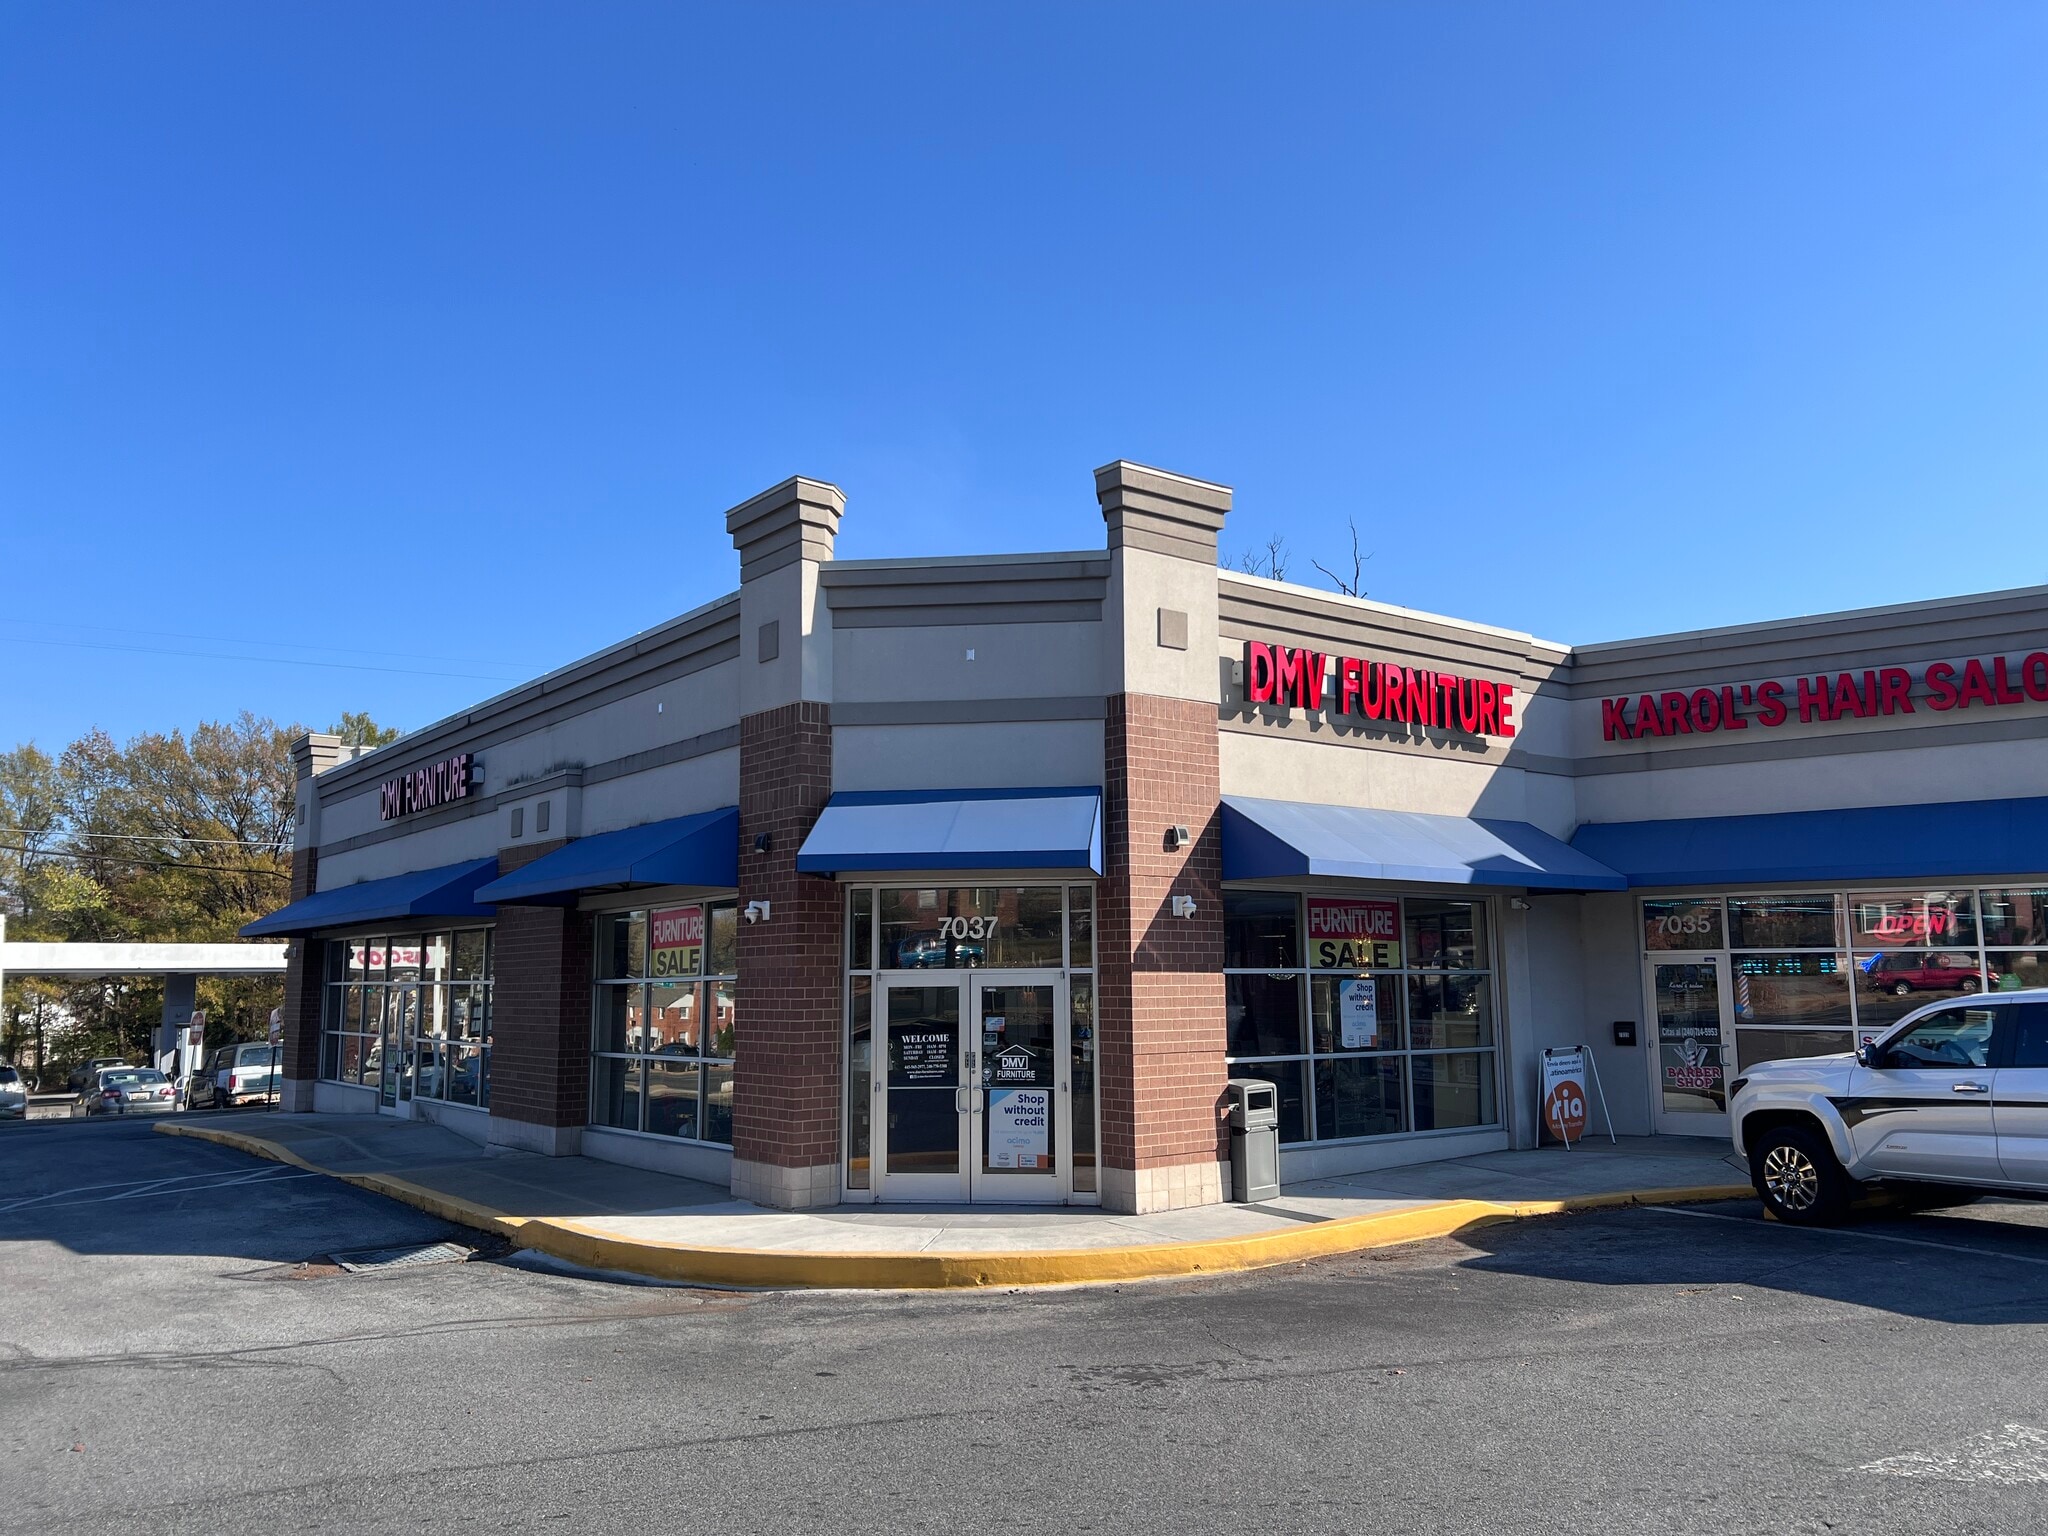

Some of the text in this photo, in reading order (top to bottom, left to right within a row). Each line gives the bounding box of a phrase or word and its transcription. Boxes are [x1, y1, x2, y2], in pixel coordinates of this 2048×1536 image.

[1244, 640, 1515, 737] DMV FURNITURE
[1602, 681, 1788, 741] KAROL'S
[1797, 668, 1915, 723] HAIR
[381, 754, 467, 821] DMV FURNITURE
[937, 916, 999, 939] 7037
[1310, 907, 1394, 935] FURNITURE
[1655, 914, 1711, 935] 7035
[1880, 914, 1947, 935] OPEN
[653, 916, 704, 943] FURNITURE
[656, 948, 700, 976] SALE
[1319, 941, 1389, 968] SALE
[1356, 983, 1373, 993] Shop
[1348, 993, 1374, 1002] without
[901, 1034, 950, 1043] WELCOME
[1002, 1057, 1026, 1068] DMV
[996, 1070, 1036, 1078] FURNITURE
[1549, 1067, 1582, 1076] atinoamérica
[1667, 1066, 1721, 1078] BARBER
[1676, 1077, 1713, 1088] SHOP
[1017, 1094, 1045, 1105] Shop
[1551, 1088, 1583, 1120] ria
[1004, 1105, 1045, 1115] without
[1014, 1116, 1045, 1126] credit
